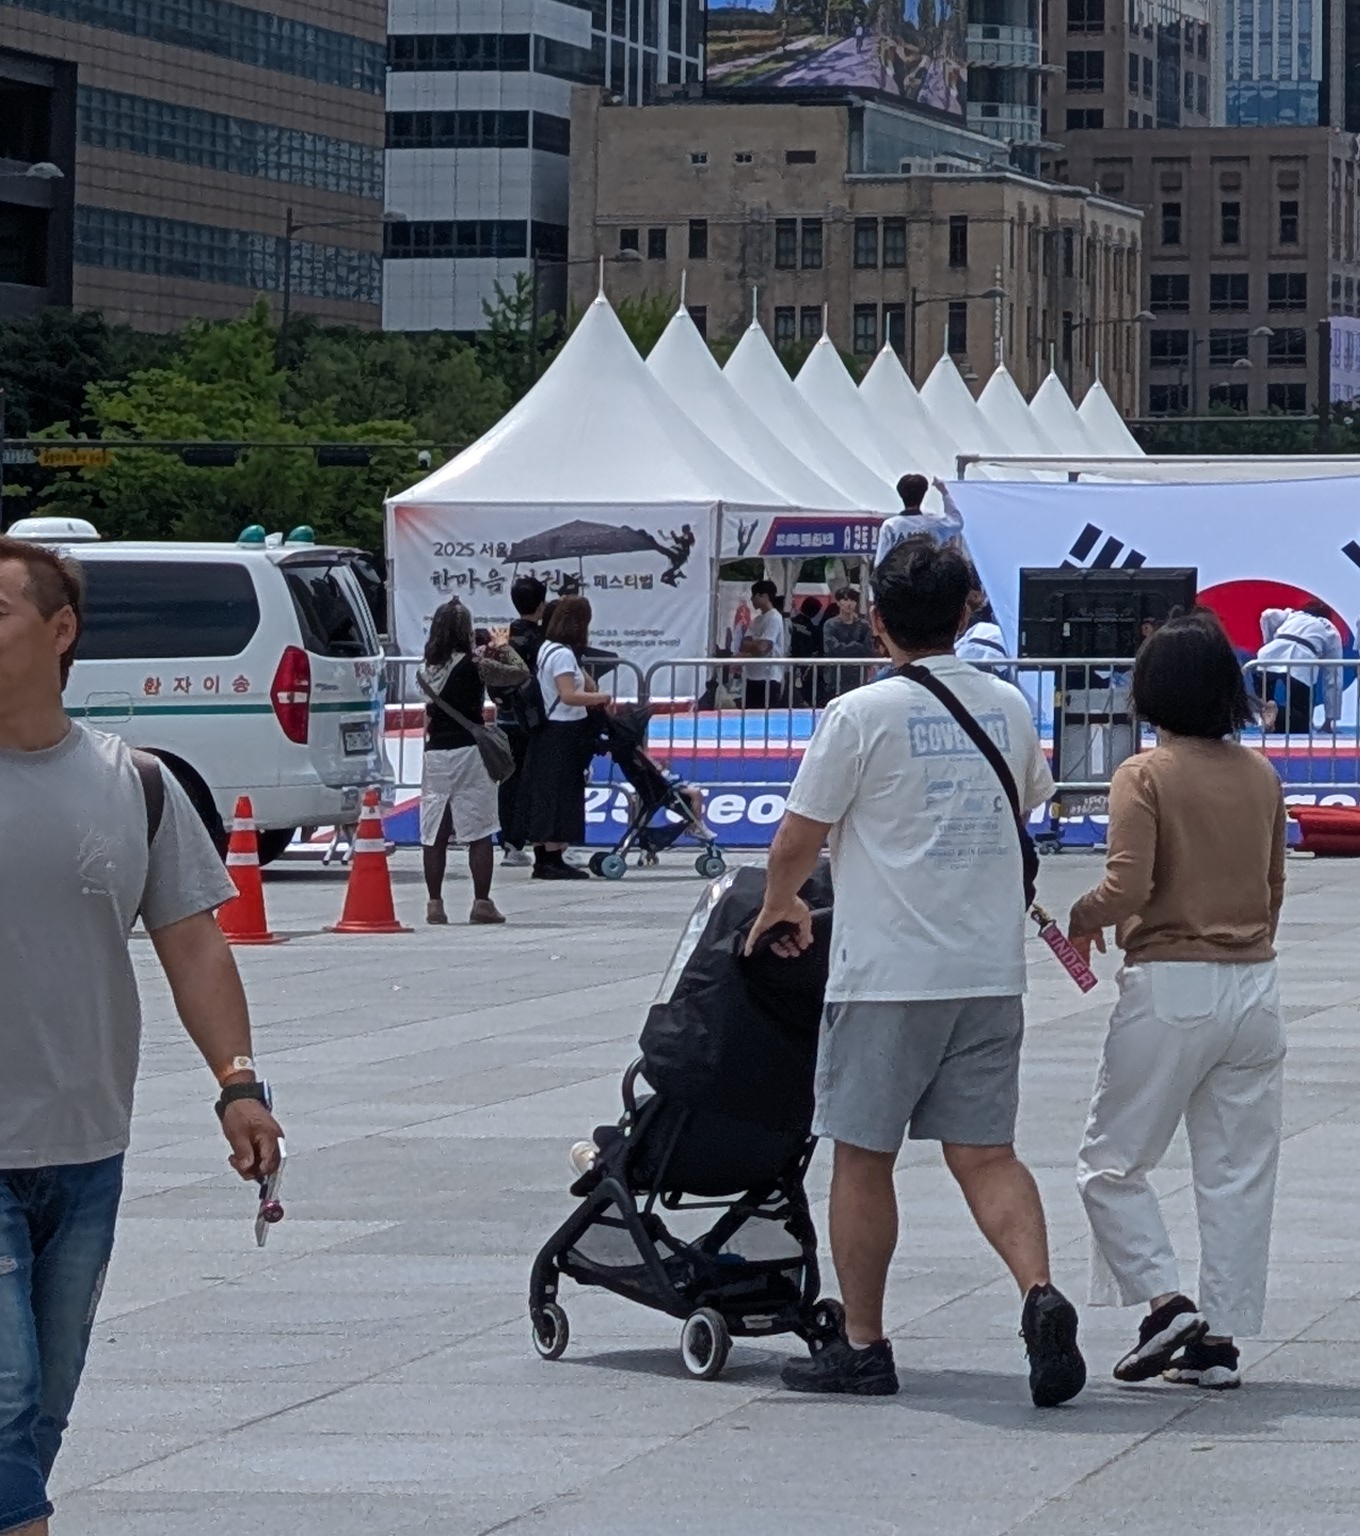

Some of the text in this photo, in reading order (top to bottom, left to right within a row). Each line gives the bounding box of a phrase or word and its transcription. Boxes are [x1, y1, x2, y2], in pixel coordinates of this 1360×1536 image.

[433, 541, 476, 557] 2025
[430, 568, 506, 596] 한마음
[593, 573, 655, 590] 페스티벌
